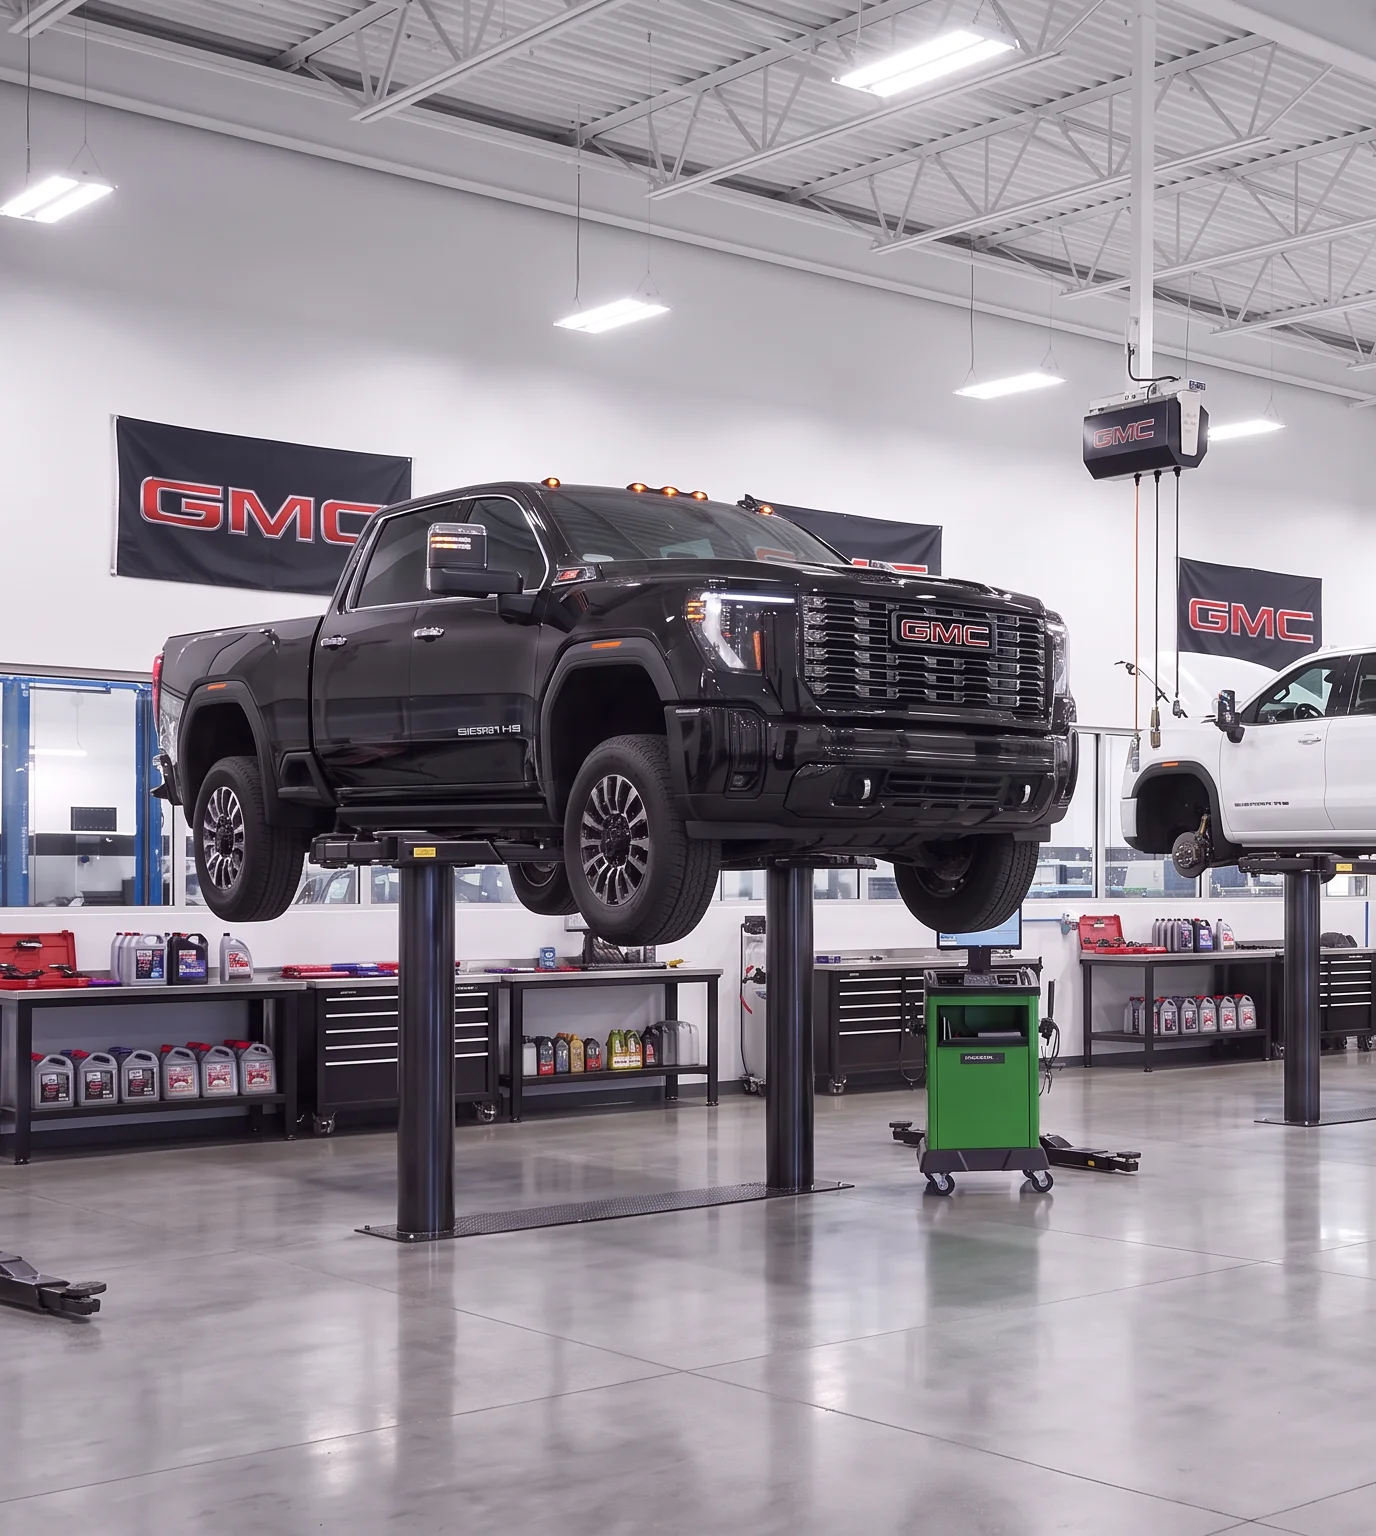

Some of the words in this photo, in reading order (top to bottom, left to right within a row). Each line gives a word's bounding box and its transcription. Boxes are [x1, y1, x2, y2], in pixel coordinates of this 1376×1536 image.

[1093, 418, 1155, 448] GMC
[139, 476, 388, 547] GMC
[901, 619, 990, 647] GMC
[1188, 597, 1314, 644] GMC
